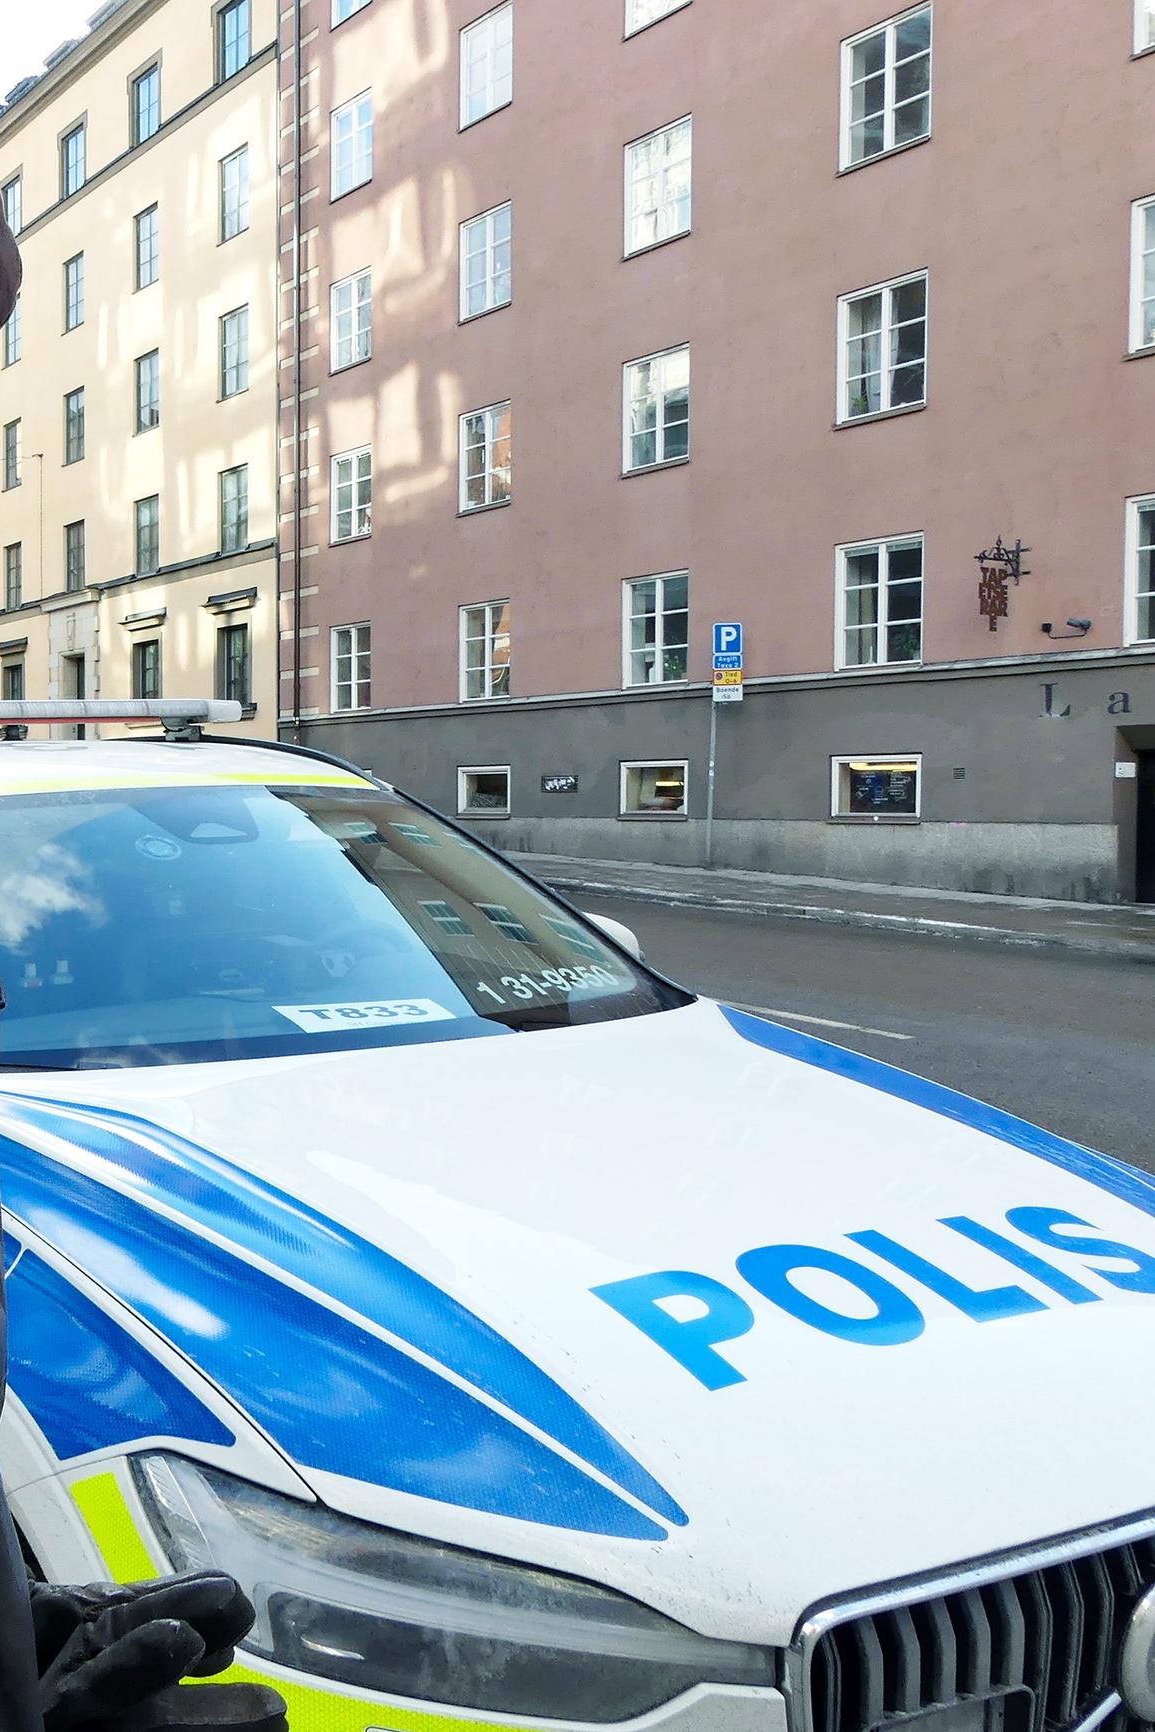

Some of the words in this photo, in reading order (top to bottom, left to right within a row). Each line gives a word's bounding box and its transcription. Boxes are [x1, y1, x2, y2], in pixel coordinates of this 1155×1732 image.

[980, 567, 1007, 583] TAP
[721, 627, 737, 651] P
[500, 965, 620, 1000] 31-9350
[299, 1004, 428, 1020] T833
[588, 1206, 1155, 1391] POLIS
